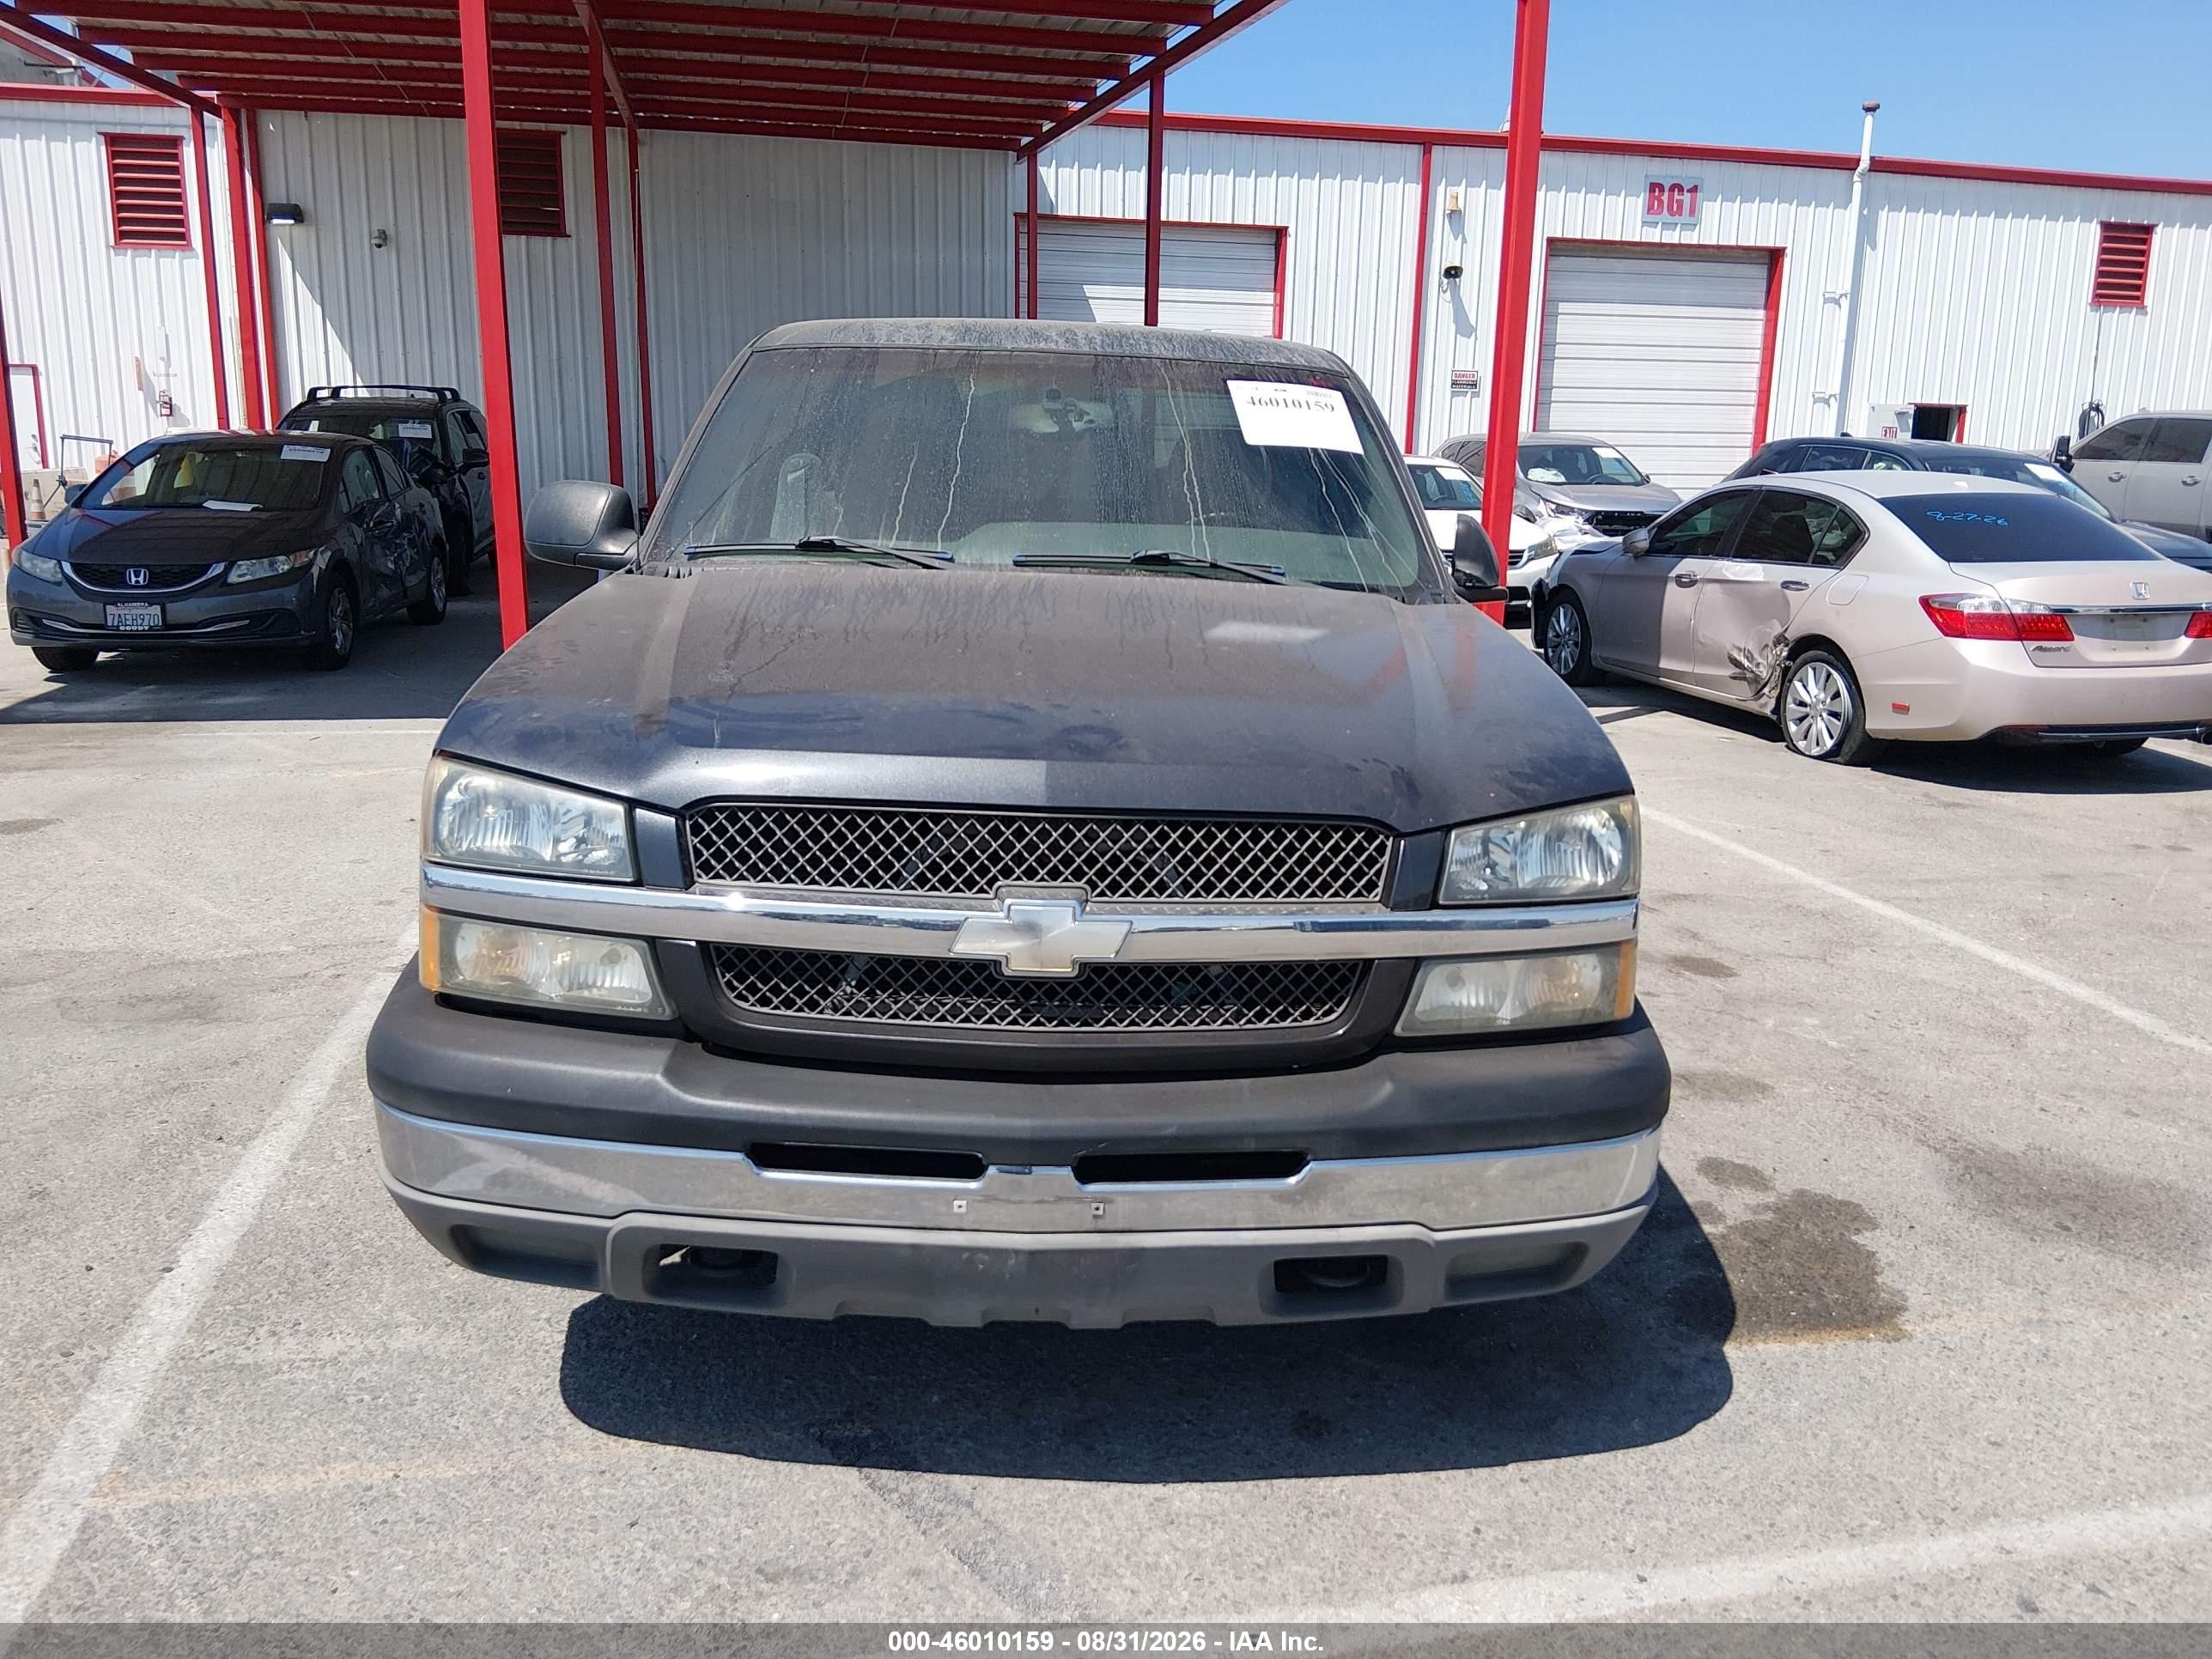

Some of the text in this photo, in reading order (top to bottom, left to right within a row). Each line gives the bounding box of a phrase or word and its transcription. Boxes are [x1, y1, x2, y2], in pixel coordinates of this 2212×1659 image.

[1647, 182, 1698, 218] BG1
[1247, 396, 1334, 412] 46010159
[1926, 511, 2008, 526] 8-27-26
[109, 613, 160, 626] 7AEH970
